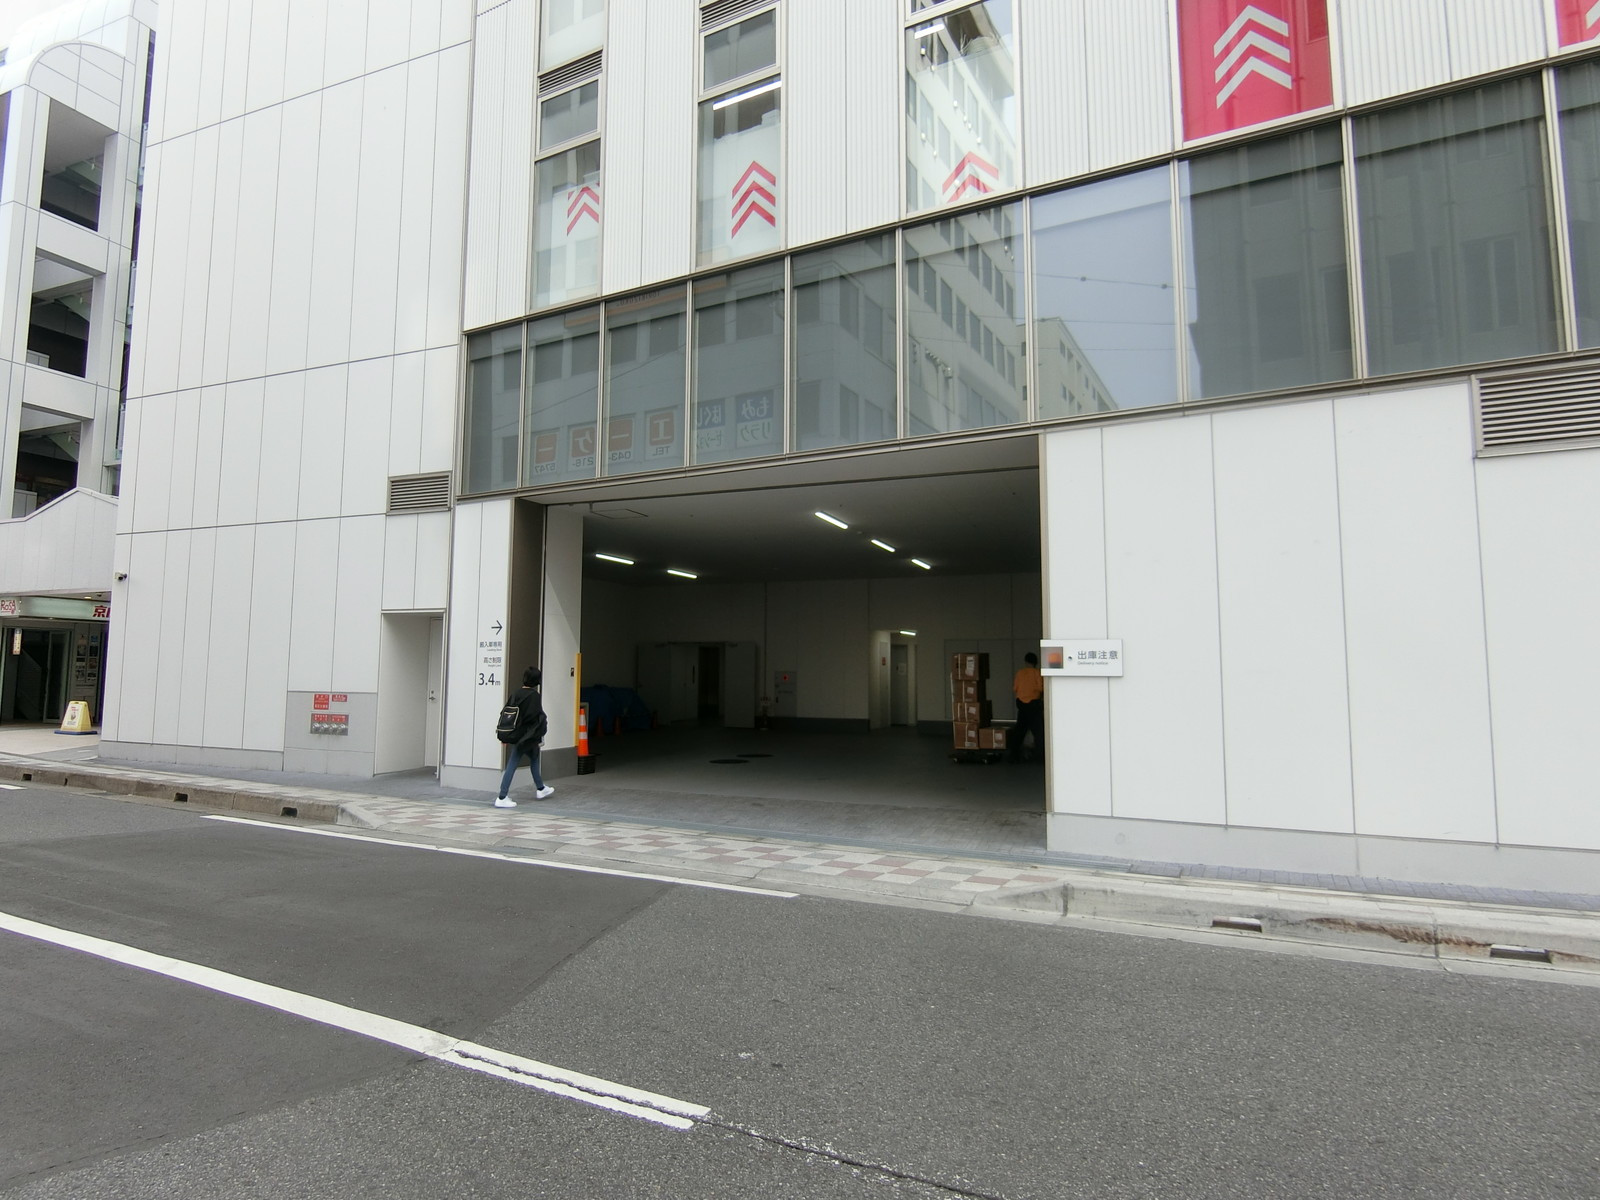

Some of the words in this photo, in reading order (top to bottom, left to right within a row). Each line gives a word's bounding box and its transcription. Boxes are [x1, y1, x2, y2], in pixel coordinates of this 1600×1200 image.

[1077, 650, 1118, 660] 出庫注意
[478, 672, 501, 686] 3.4m
